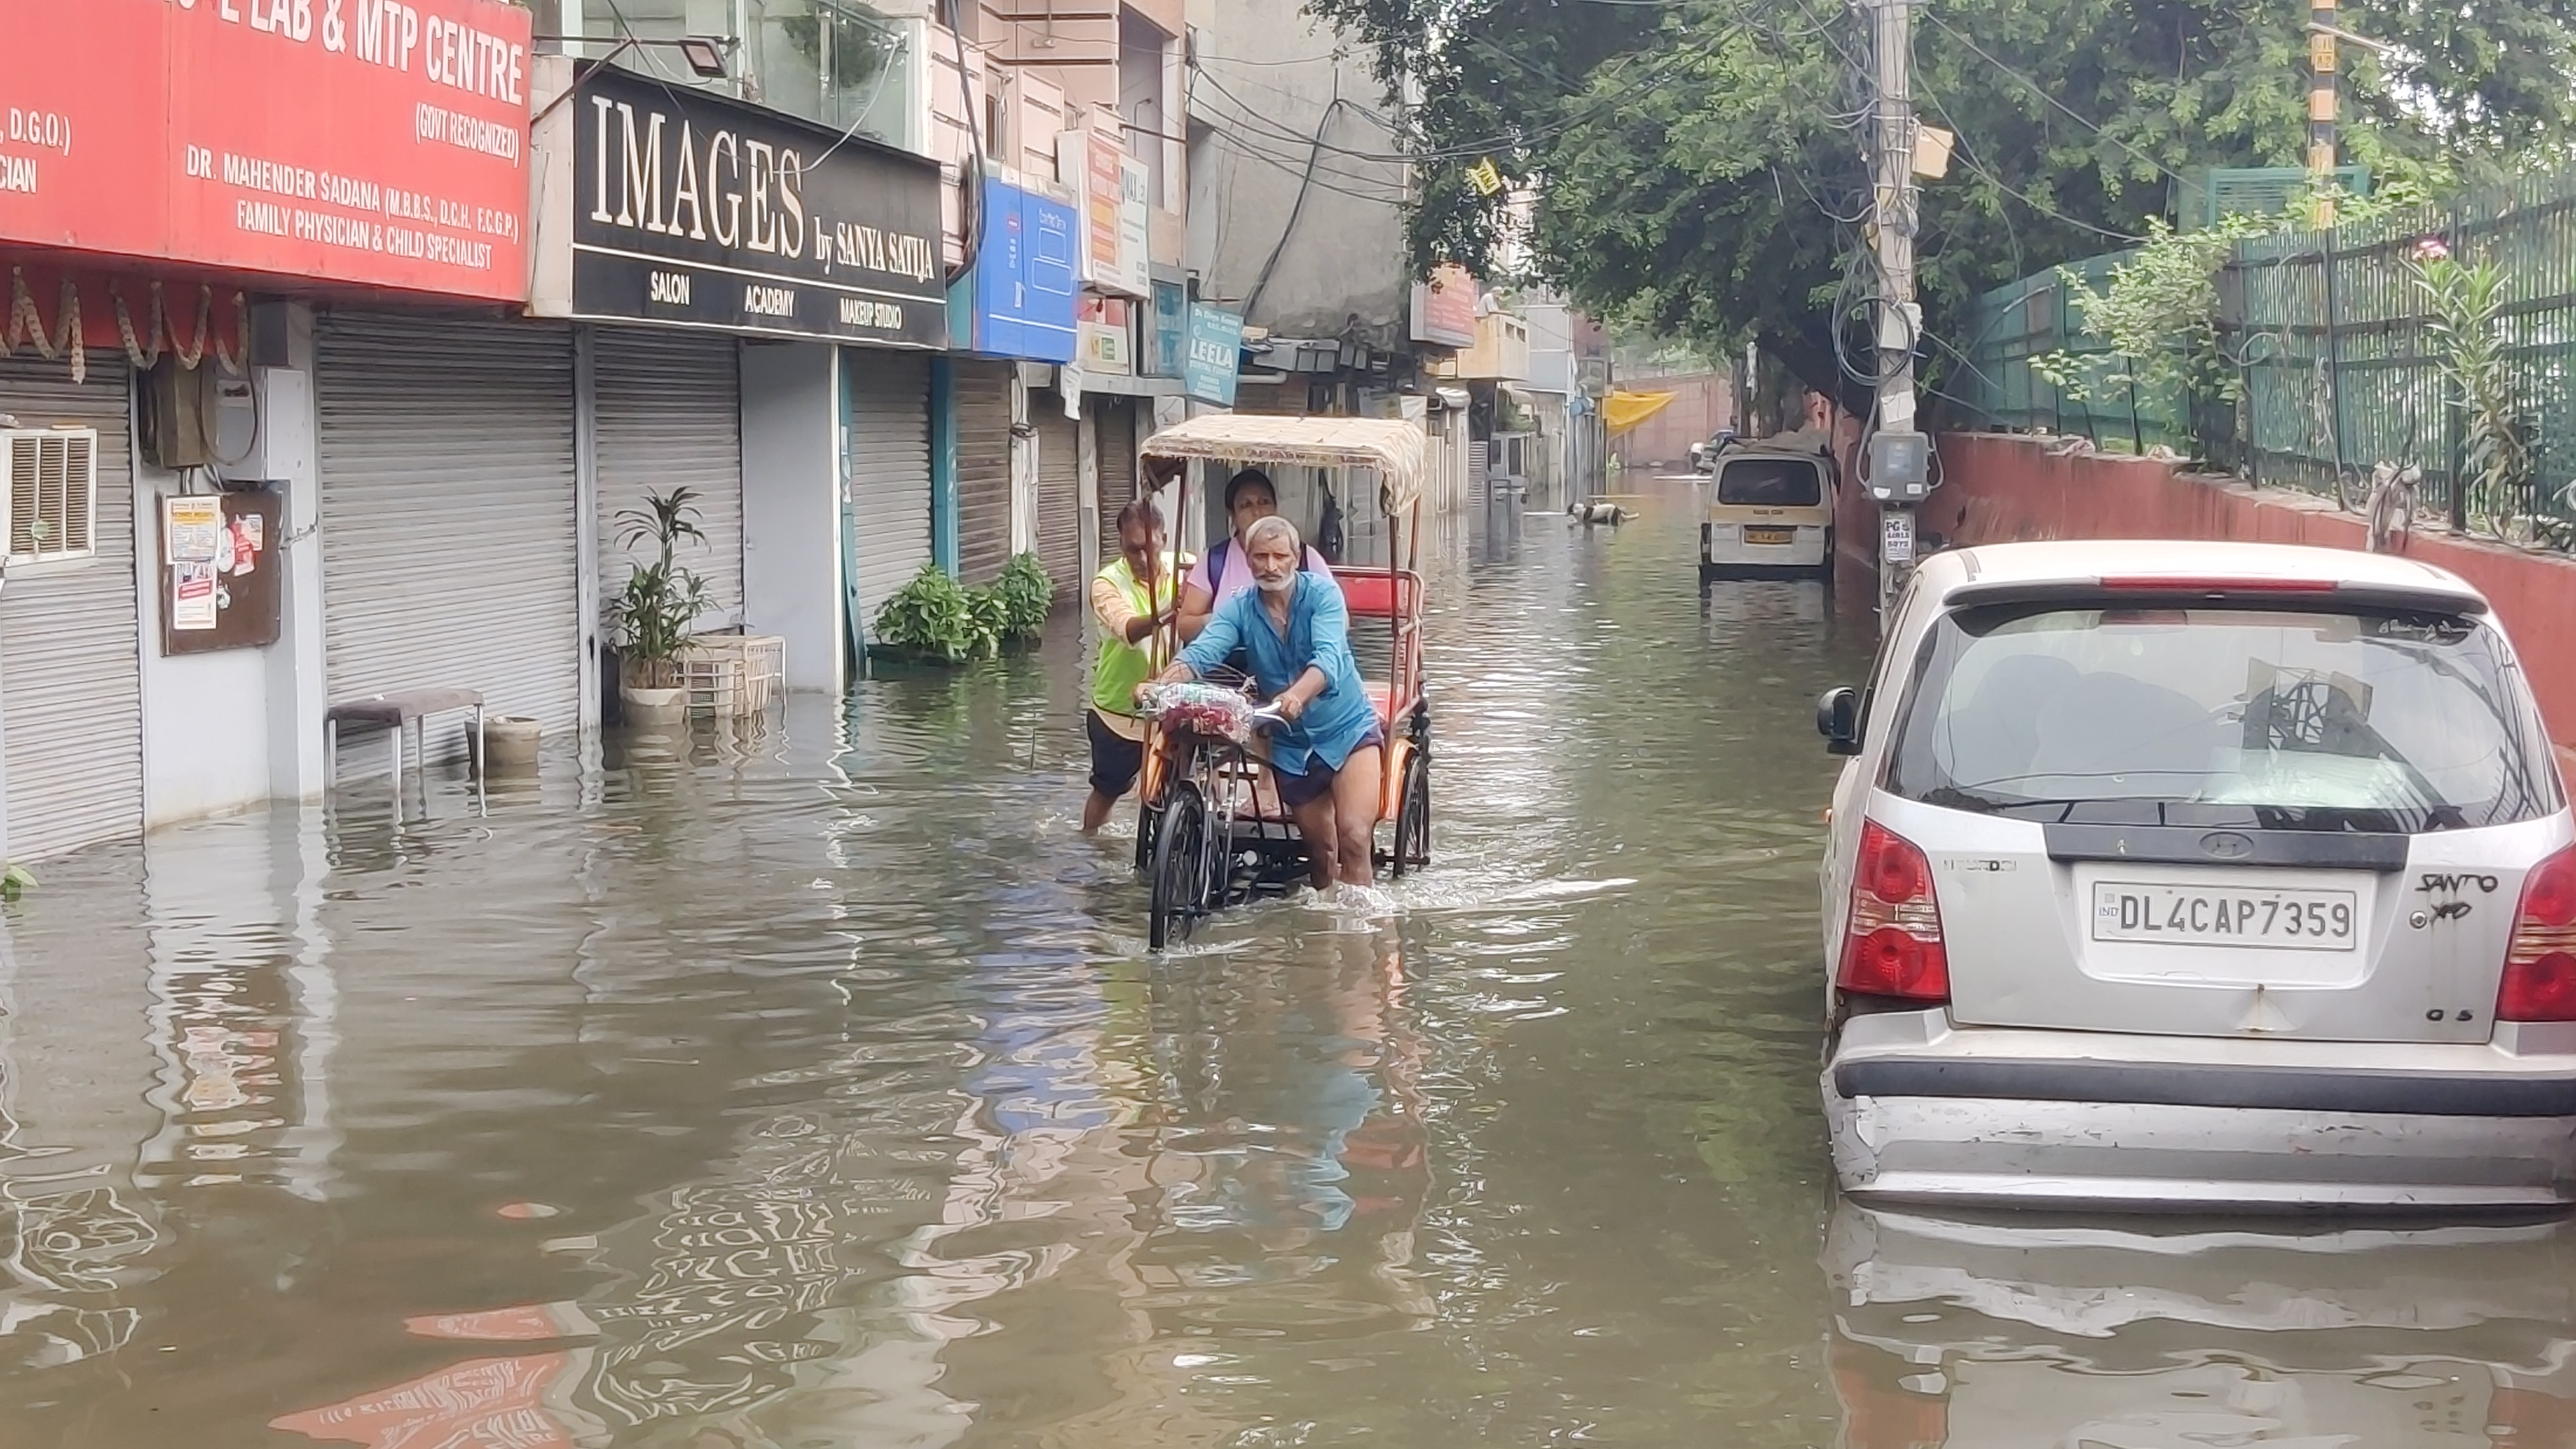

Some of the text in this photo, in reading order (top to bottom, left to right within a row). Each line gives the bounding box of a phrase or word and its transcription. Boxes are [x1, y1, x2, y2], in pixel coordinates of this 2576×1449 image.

[323, 0, 346, 54] &
[358, 0, 418, 72] MTP
[427, 15, 523, 106] CENTRE
[10, 107, 70, 156] D.G.O.)
[416, 102, 519, 168] (GOVT RECOGNIZED)
[187, 143, 217, 180] DR.
[223, 152, 317, 200] MAHENDER
[321, 170, 381, 212] SADANA
[592, 95, 934, 283] IMAGES by SANYA SATIJA
[237, 199, 492, 270] FAMILY PHYSICIAN & CHILD SPECIALIST
[651, 271, 903, 330] SALON ACADEMY MAKEUP STUDIO
[1190, 338, 1233, 369] LEELA
[2099, 895, 2349, 937] IND DL4CAP7359
